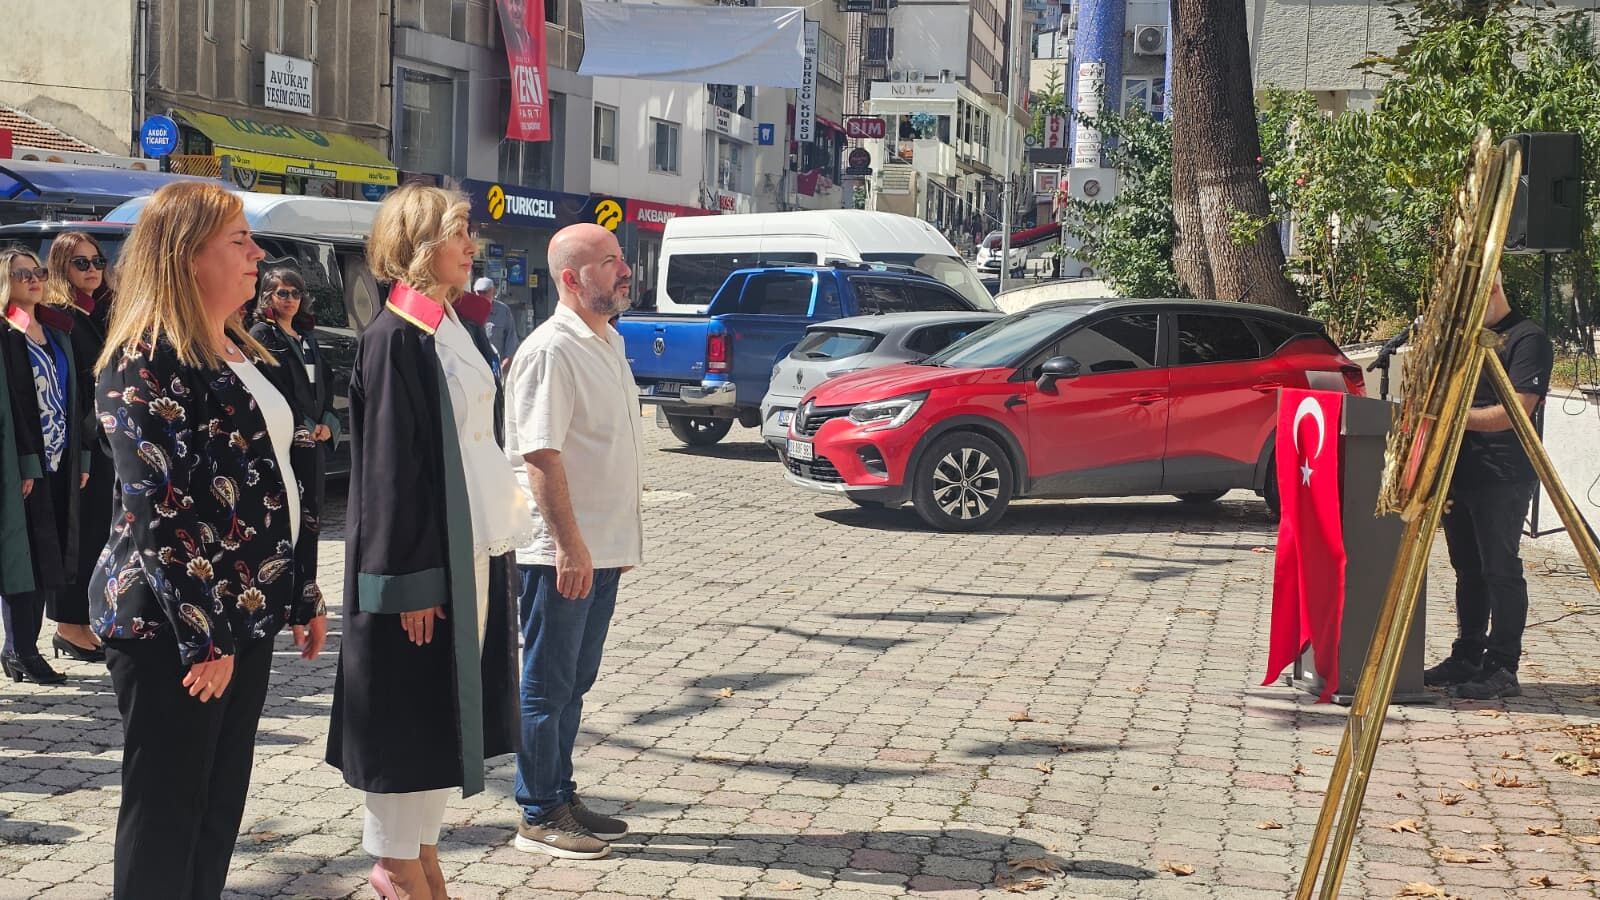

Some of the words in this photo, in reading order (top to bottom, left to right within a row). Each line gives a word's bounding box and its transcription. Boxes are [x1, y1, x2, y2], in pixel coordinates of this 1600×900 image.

[270, 70, 309, 90] AVUKAT
[266, 86, 288, 106] YEŞİM
[289, 88, 311, 109] GÜNER
[800, 104, 811, 140] KURSU
[850, 119, 881, 135] BİM
[504, 194, 556, 219] TURKCELL
